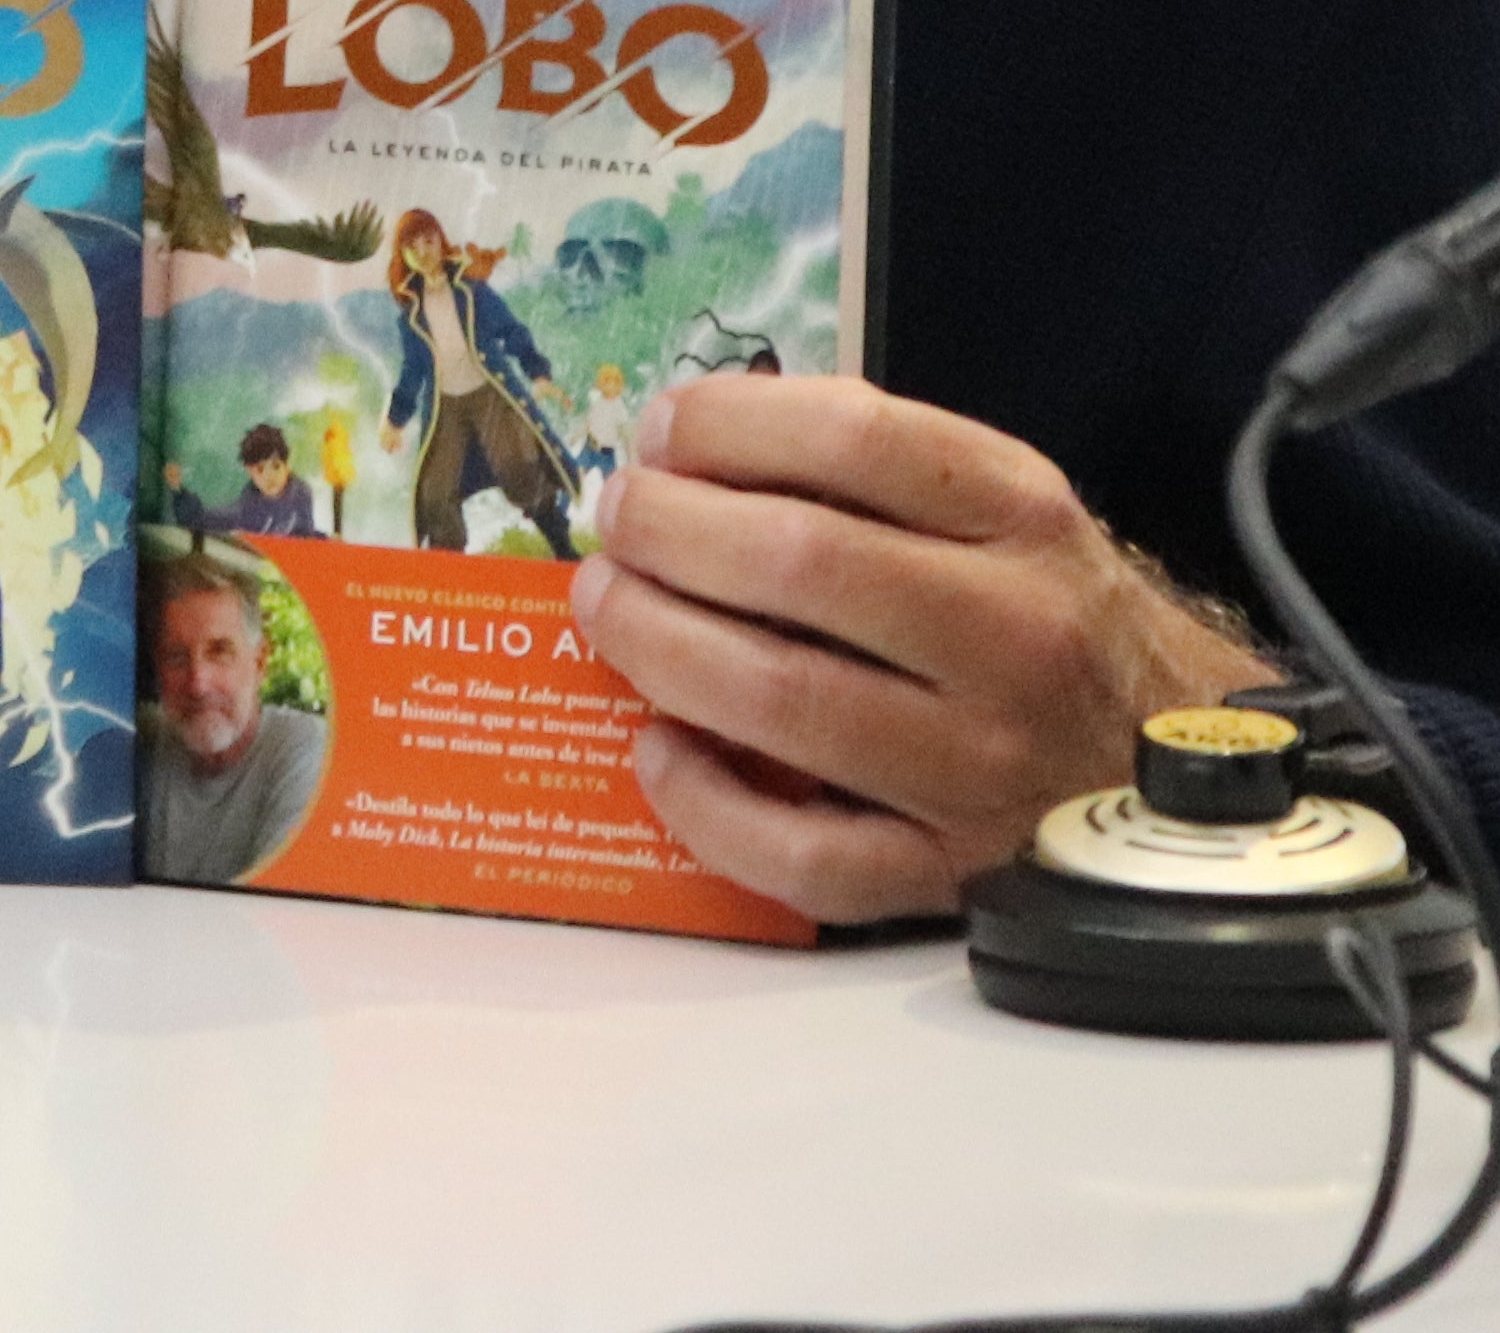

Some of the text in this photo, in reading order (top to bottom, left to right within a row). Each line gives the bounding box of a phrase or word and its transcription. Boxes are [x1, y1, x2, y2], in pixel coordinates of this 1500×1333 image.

[328, 139, 652, 176] LA LEYENDA DEL PIRATA
[510, 597, 574, 617] CONTE
[371, 611, 595, 662] EMILIO A
[466, 680, 515, 702] Telmo
[518, 685, 563, 706] Lobo
[372, 694, 398, 718] las
[401, 698, 477, 726] historias
[480, 713, 515, 732] que
[518, 716, 538, 732] se
[416, 735, 446, 751] sus
[450, 735, 504, 756] nietos
[508, 743, 556, 761] antes
[558, 740, 581, 764] de
[421, 800, 463, 822] todo
[466, 803, 485, 825] lo
[487, 810, 522, 831] que
[551, 811, 575, 833] de
[347, 819, 396, 849] Moby
[449, 830, 474, 851] La
[475, 830, 544, 858] historia
